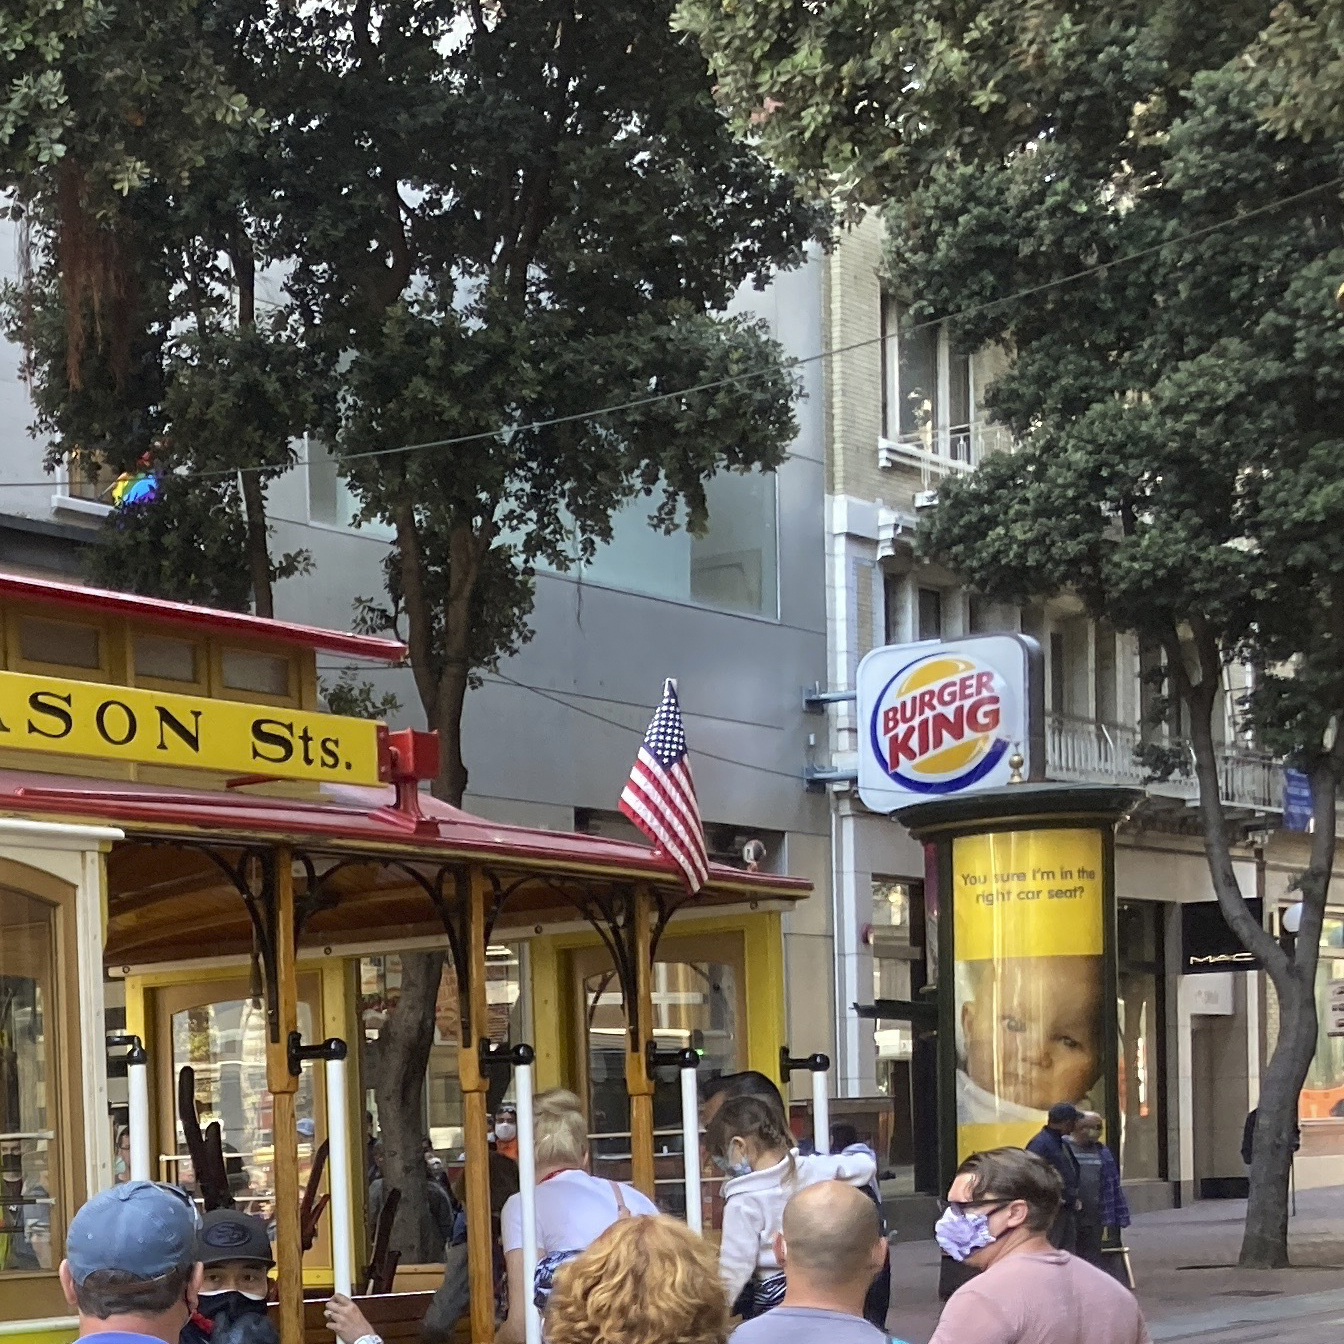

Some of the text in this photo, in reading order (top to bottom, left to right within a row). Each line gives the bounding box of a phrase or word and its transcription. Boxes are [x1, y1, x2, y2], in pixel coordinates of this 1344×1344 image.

[883, 670, 995, 737] BURGER
[250, 718, 353, 771] Sts.
[888, 695, 1001, 774] KING
[961, 866, 1096, 887] You sure I'm in the
[975, 886, 1085, 906] right car seat?
